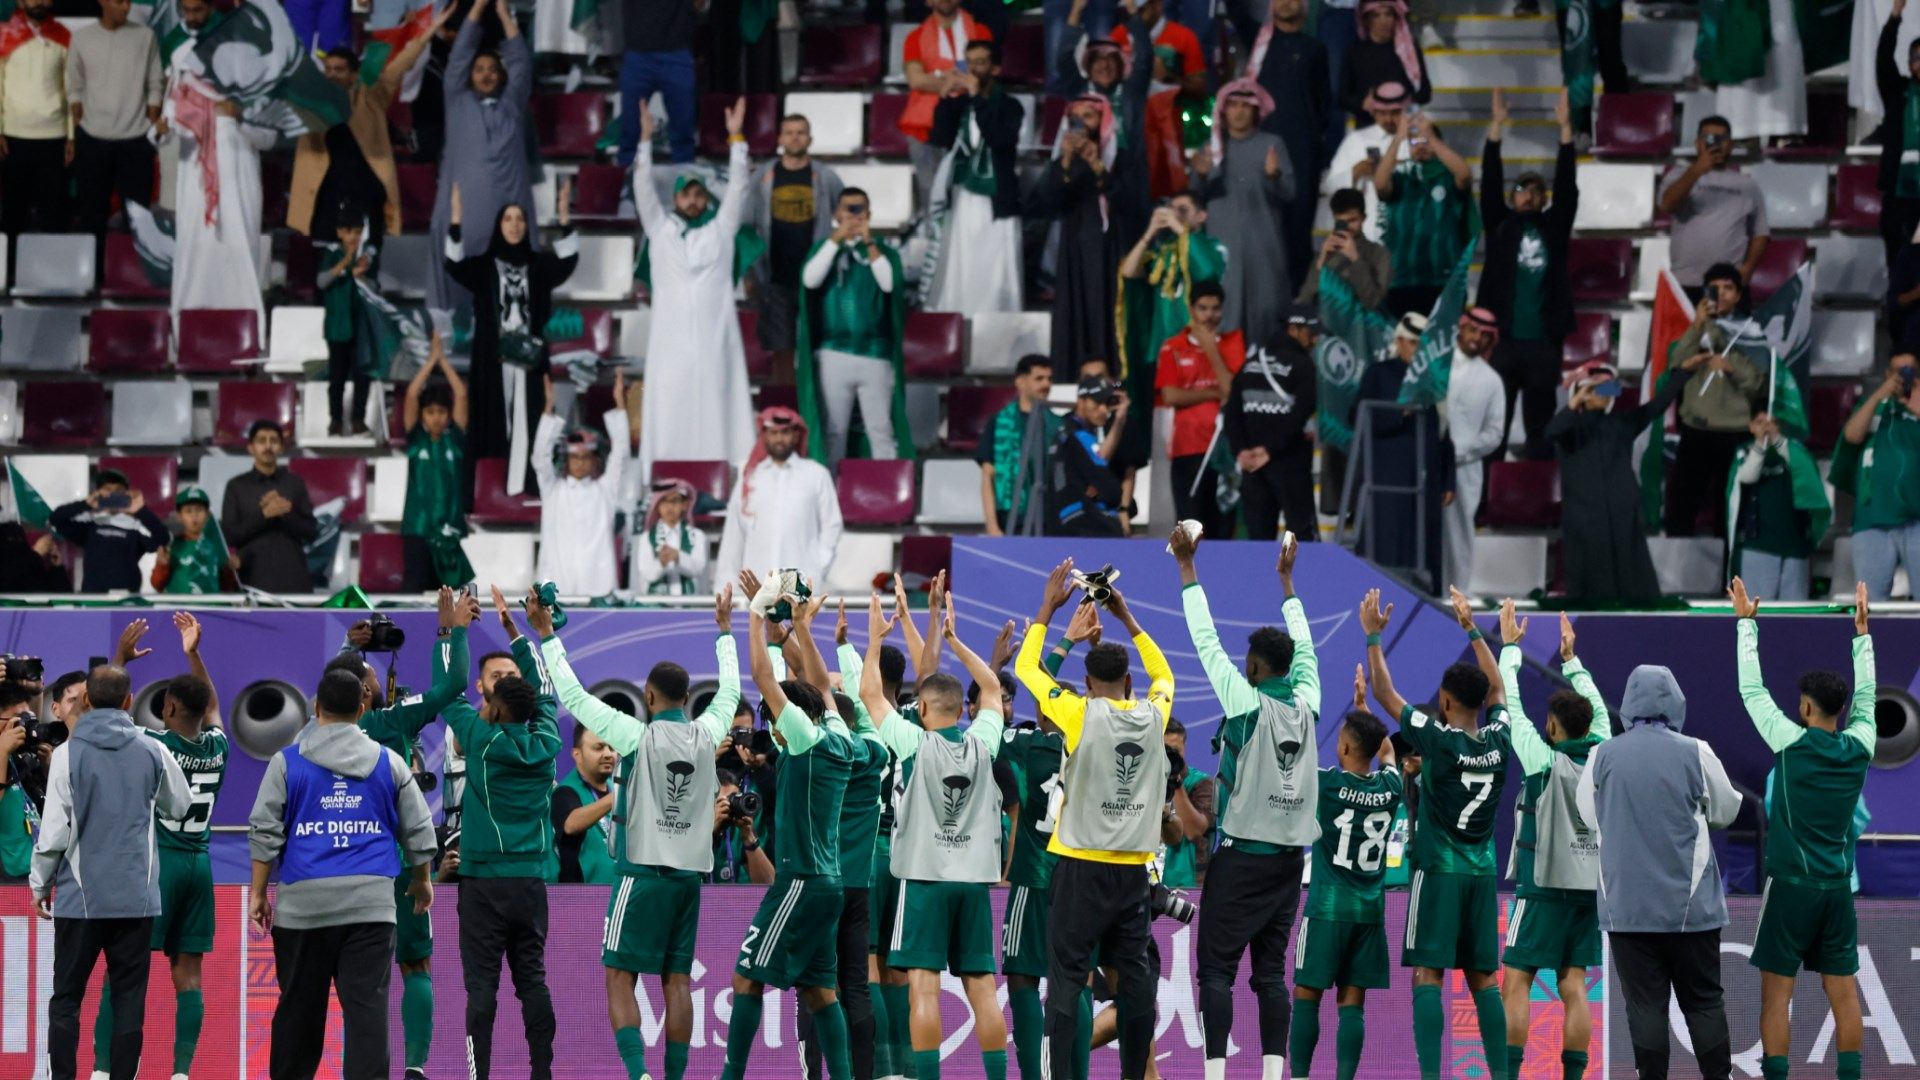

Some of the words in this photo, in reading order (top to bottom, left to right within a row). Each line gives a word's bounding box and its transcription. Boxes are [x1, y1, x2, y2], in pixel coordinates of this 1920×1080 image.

[158, 772, 220, 833] 5
[320, 795, 345, 803] ASIAN
[345, 795, 363, 803] CUP
[1101, 802, 1125, 810] ASIAN
[1456, 772, 1494, 830] 7
[296, 822, 324, 836] AFC
[328, 820, 382, 834] DIGITAL
[333, 836, 349, 848] 12
[954, 835, 971, 843] CUP
[1332, 808, 1392, 872] 18
[741, 925, 760, 953] 2
